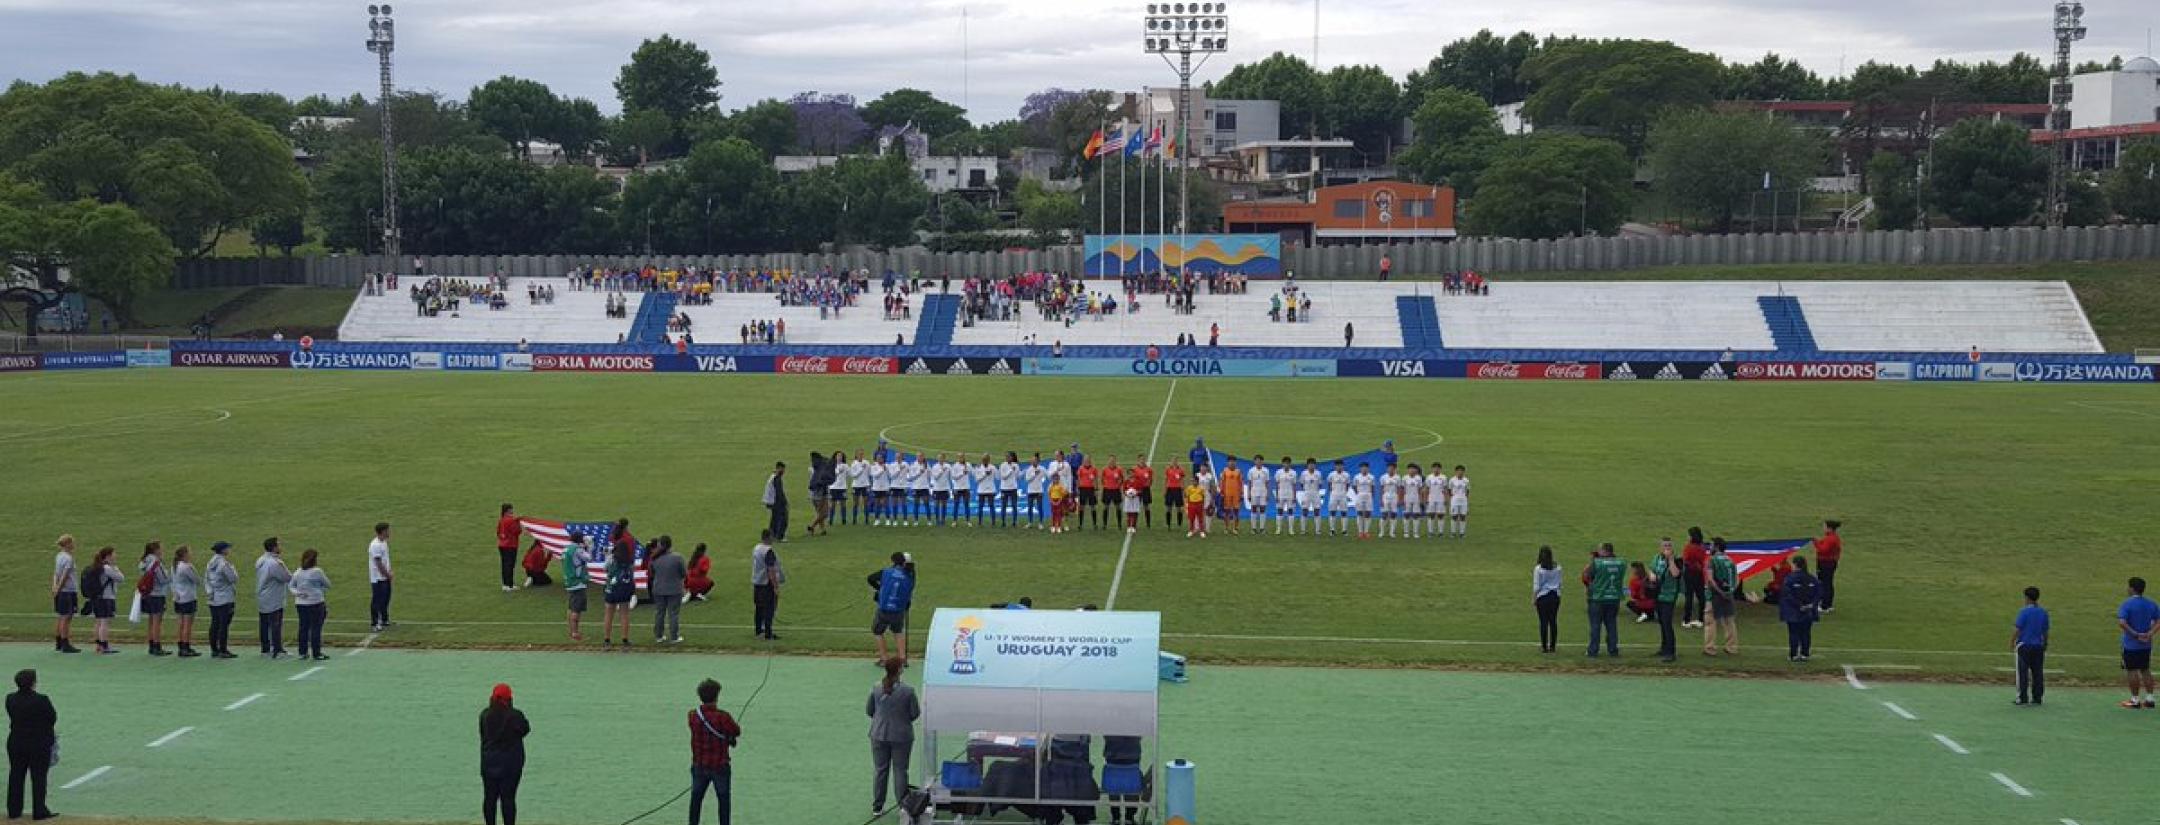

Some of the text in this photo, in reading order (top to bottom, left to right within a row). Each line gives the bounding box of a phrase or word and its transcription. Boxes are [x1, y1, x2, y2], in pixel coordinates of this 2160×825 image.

[181, 352, 223, 365] QATAR
[226, 353, 279, 366] AIRWAYS
[315, 353, 411, 368] 万达 WANDA
[447, 354, 497, 367] GAZPROM
[559, 356, 654, 370] KIA MOTORS
[696, 356, 737, 371] VISA
[1131, 358, 1223, 375] COLONIA
[1382, 360, 1425, 377] VISA
[1767, 364, 1796, 378] KIA
[1801, 364, 1874, 378] MOTORS
[1915, 364, 1974, 379] GAZPROM
[2045, 365, 2154, 381] 万达 WANDA
[1012, 635, 1066, 643] WOMEN'S
[1068, 636, 1108, 644] WORLD
[1111, 637, 1133, 645] CUP
[996, 643, 1119, 658] URUGUAY 2018
[953, 663, 974, 673] FIFA
